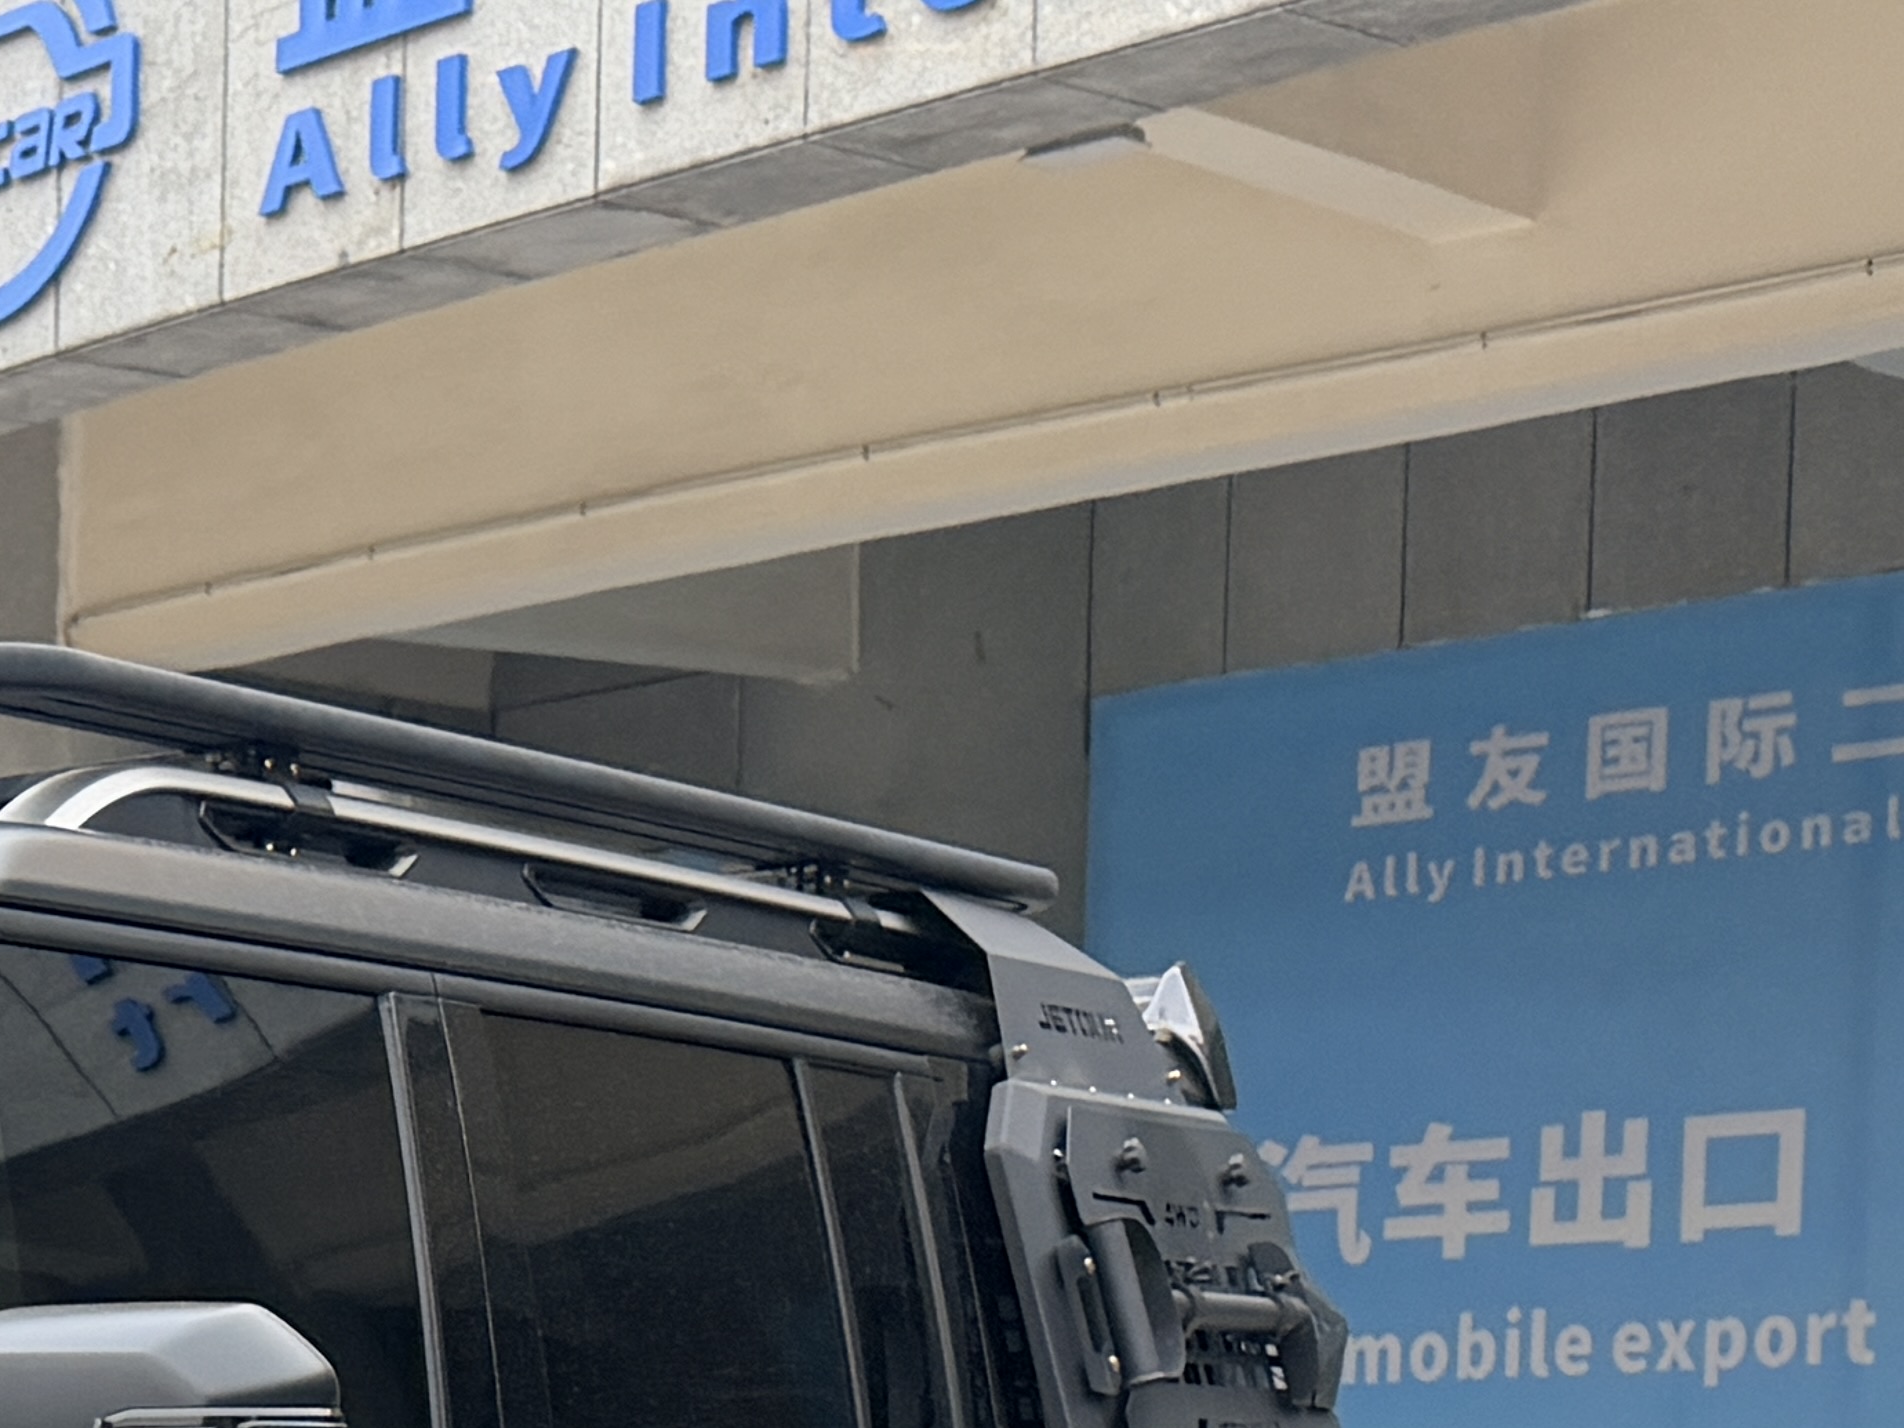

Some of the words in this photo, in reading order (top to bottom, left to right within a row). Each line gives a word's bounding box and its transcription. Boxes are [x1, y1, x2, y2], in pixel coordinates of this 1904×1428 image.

[258, 46, 580, 219] Ally
[1349, 684, 1904, 828] 盟友国际二
[1344, 850, 1456, 904] Ally
[1471, 793, 1902, 887] International
[1611, 1298, 1877, 1388] export
